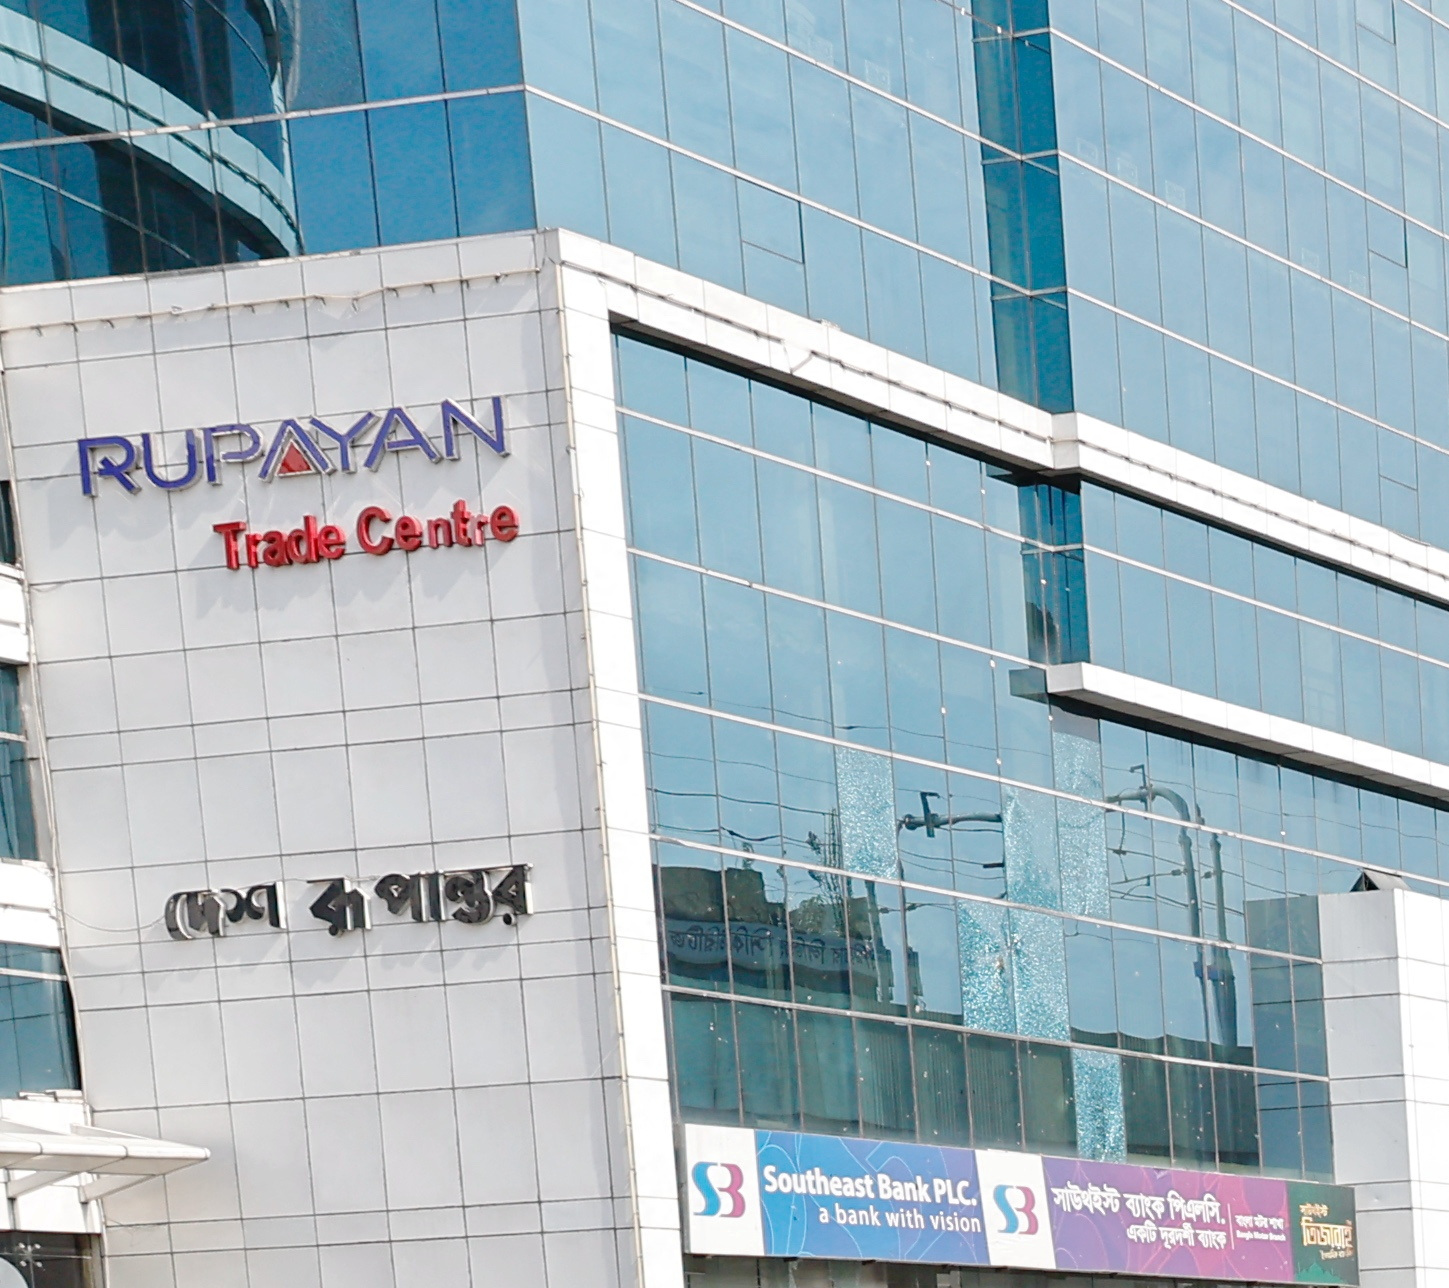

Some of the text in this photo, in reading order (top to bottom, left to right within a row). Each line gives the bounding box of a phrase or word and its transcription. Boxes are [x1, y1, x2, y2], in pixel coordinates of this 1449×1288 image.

[77, 396, 511, 498] RUPAYAN
[214, 499, 520, 571] Trade Centre
[164, 881, 287, 941] দেশ
[763, 1165, 978, 1206] Southeast Bank PLC.
[1051, 1180, 1121, 1215] সাউথইস্ট
[1124, 1193, 1165, 1220] ব্যাংক
[819, 1203, 981, 1233] a bank with vision
[1127, 1224, 1157, 1245] একটি
[1198, 1229, 1227, 1250] ব্যাংক
